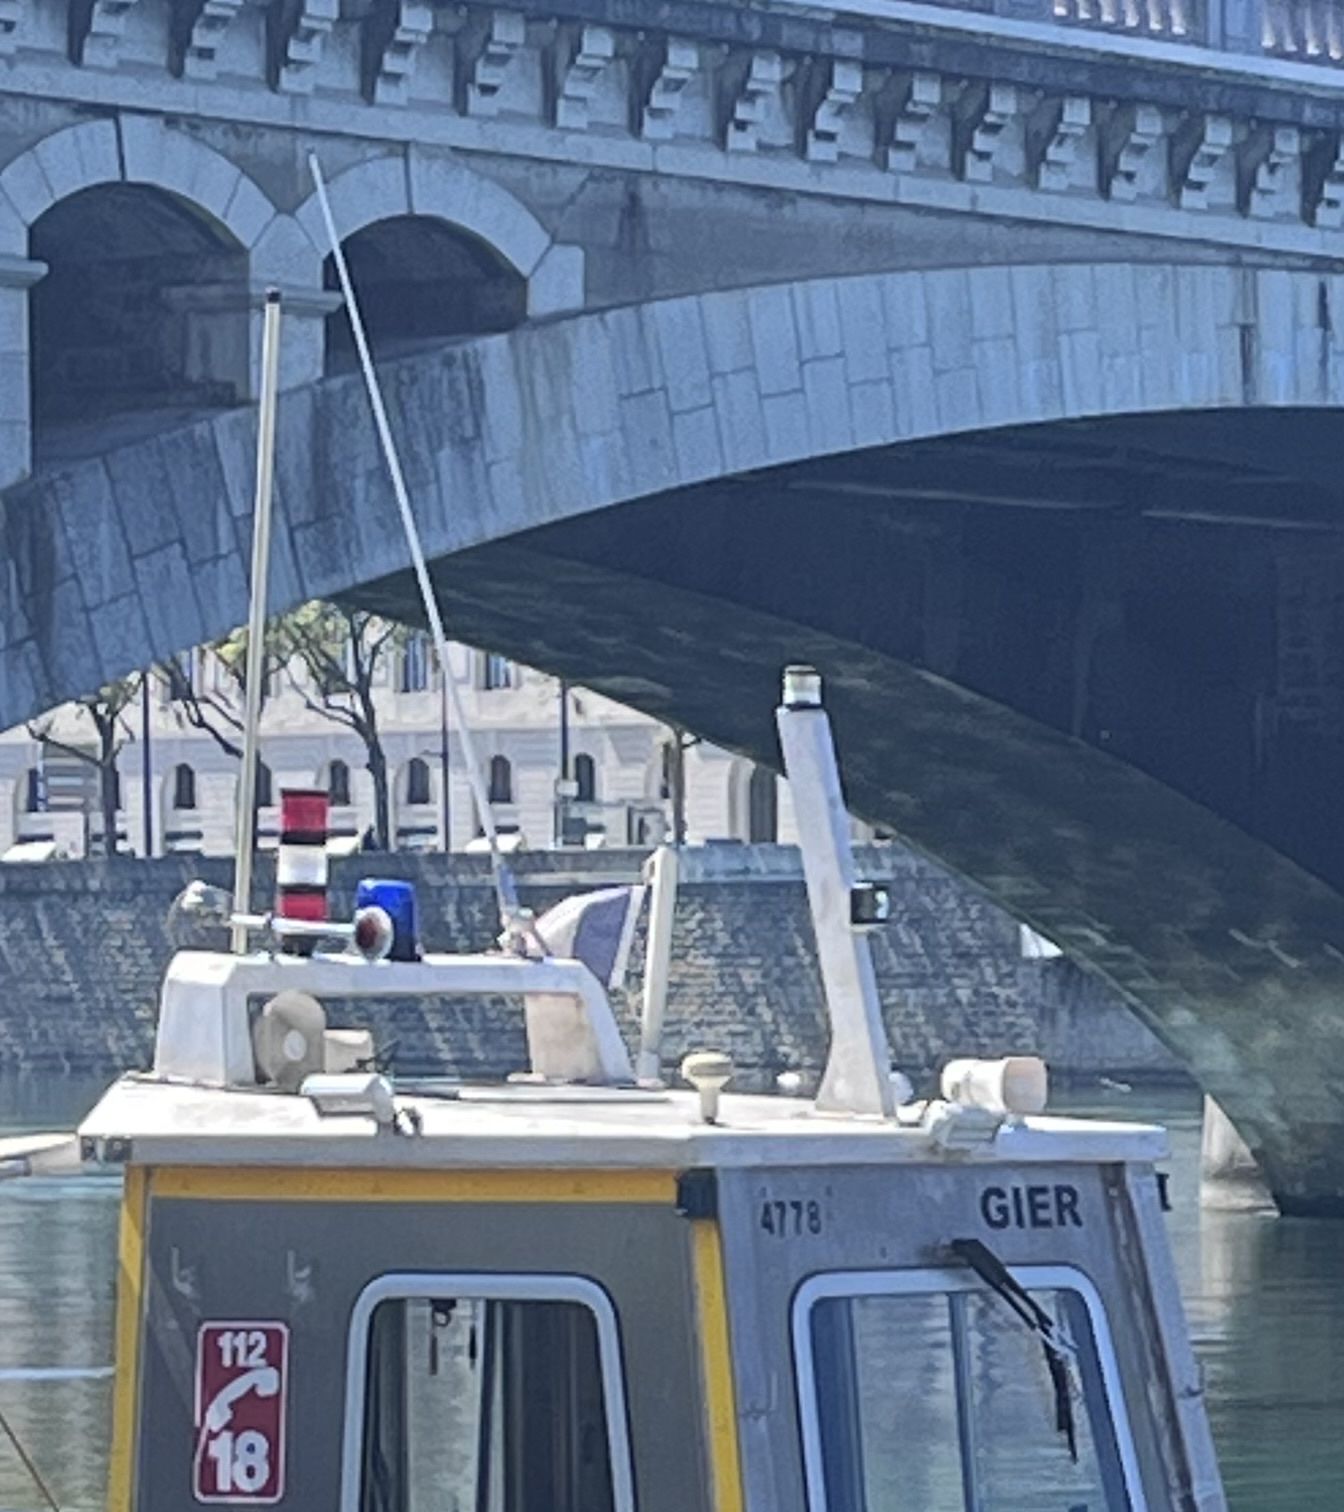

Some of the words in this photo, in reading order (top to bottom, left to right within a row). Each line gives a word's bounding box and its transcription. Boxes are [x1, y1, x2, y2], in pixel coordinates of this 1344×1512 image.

[760, 1200, 822, 1238] 4778
[980, 1185, 1083, 1229] GIER
[217, 1331, 267, 1367] 112
[208, 1429, 270, 1492] 18
